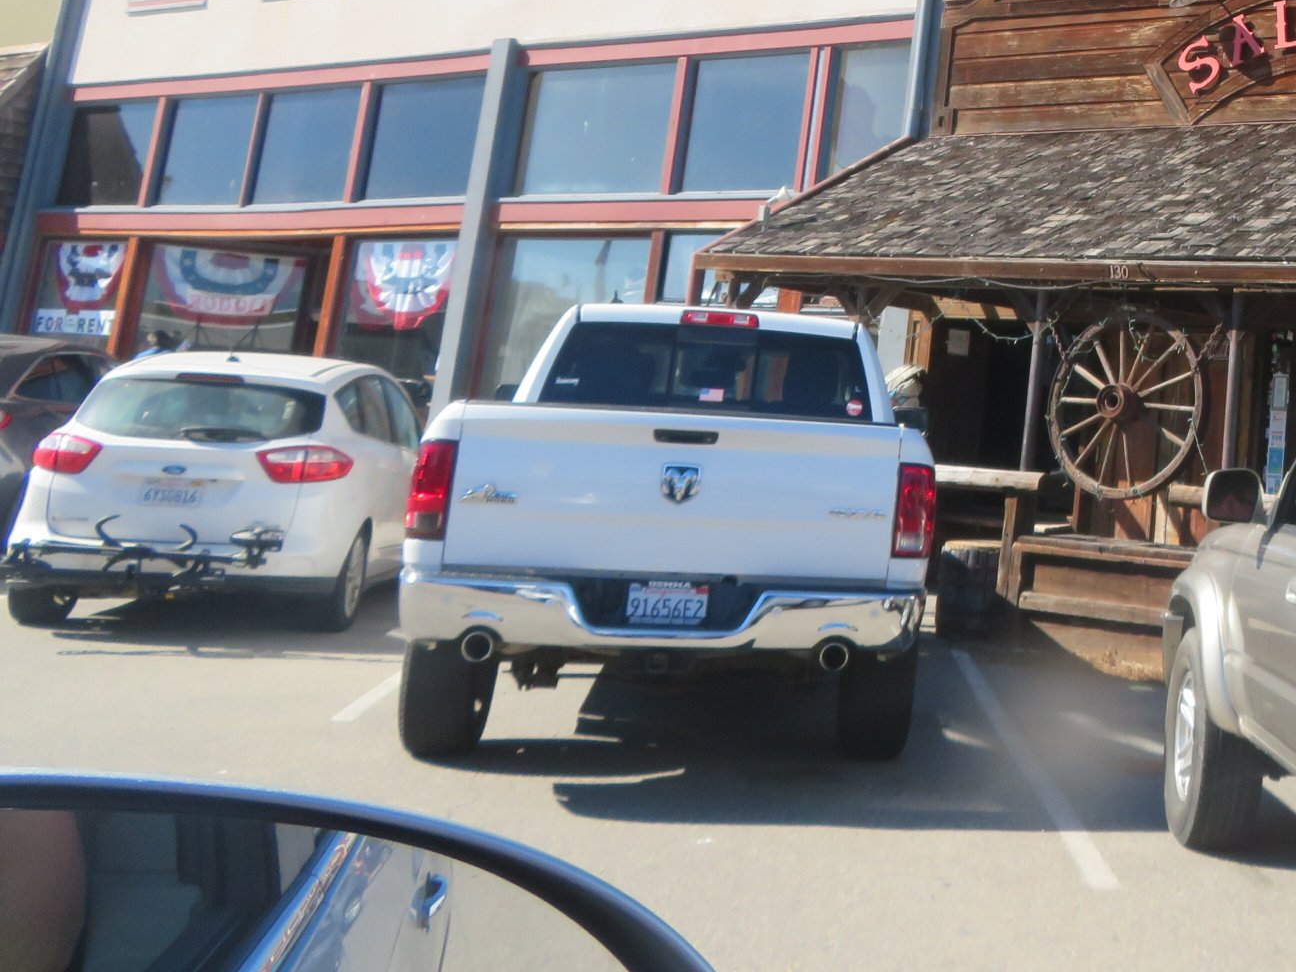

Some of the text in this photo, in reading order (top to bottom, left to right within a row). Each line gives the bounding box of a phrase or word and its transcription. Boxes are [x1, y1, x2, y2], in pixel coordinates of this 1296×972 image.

[1109, 263, 1129, 279] 130
[36, 316, 115, 334] FOR RENT
